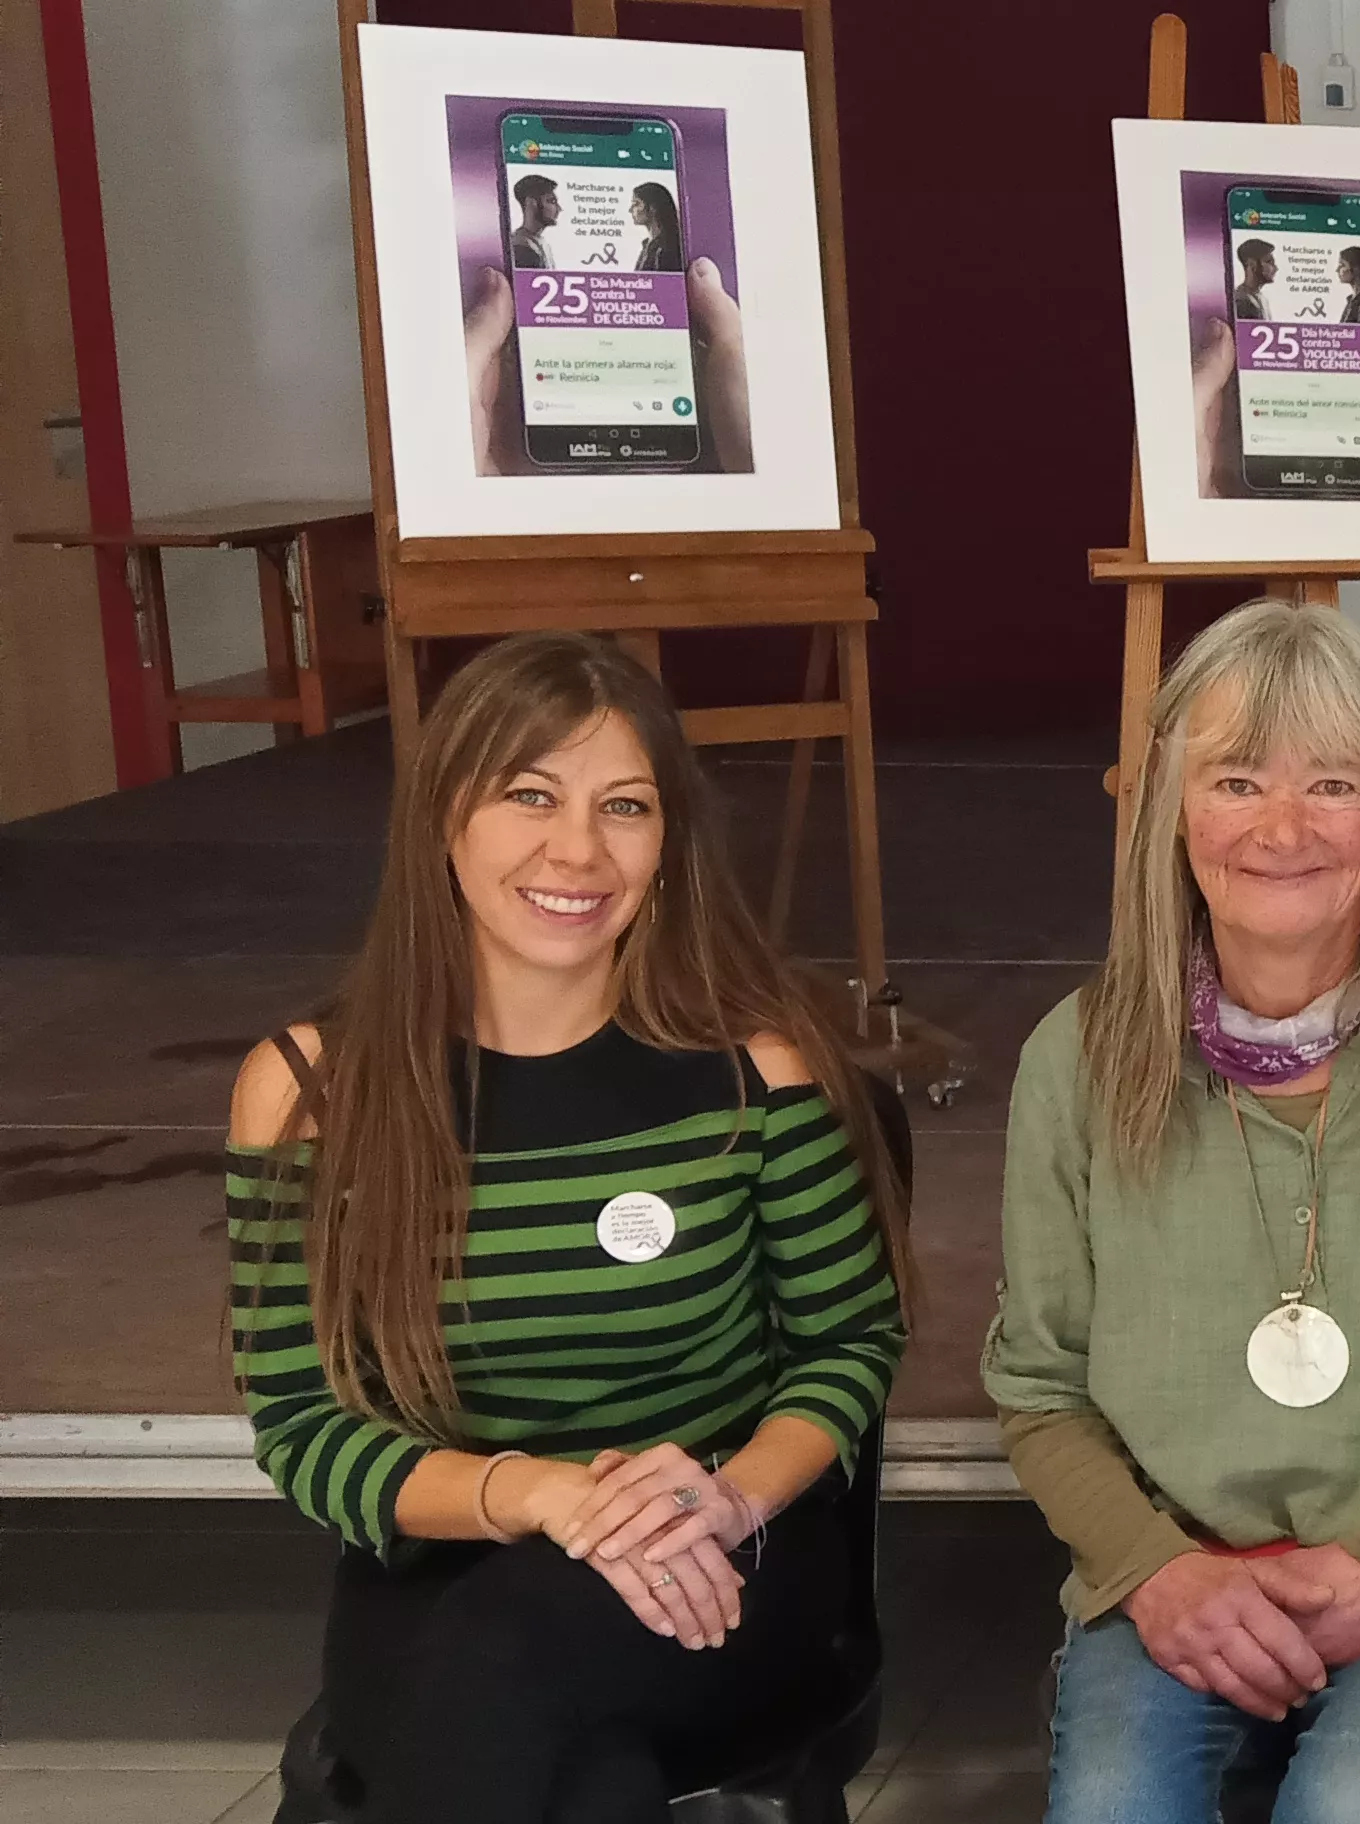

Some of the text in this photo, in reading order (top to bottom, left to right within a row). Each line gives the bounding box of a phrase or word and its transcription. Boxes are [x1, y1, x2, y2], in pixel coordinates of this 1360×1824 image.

[567, 182, 615, 191] Marcharse
[573, 195, 606, 203] tiempo
[578, 205, 616, 215] la mejor
[571, 216, 625, 226] declaración
[575, 228, 622, 237] de AMOR
[1283, 245, 1325, 254] Marcharse
[1288, 256, 1317, 264] tiempo
[590, 277, 653, 289] Día Mundial
[1302, 285, 1330, 293] AMOR
[531, 275, 589, 314] 25
[591, 290, 636, 300] contra la
[592, 302, 659, 313] VIOLENCIA
[546, 316, 587, 324] Noviembre
[593, 312, 665, 325] DE GÉNERO
[1302, 328, 1356, 339] Día Mundial
[1251, 326, 1299, 360] 25
[1302, 339, 1340, 348] contra la
[1302, 349, 1360, 359] VIOLENCIA
[534, 359, 560, 369] Ante
[562, 359, 572, 369] la
[574, 360, 614, 370] primera
[616, 360, 651, 369] alarma
[1304, 360, 1318, 369] DE
[560, 372, 600, 382] Reinicia
